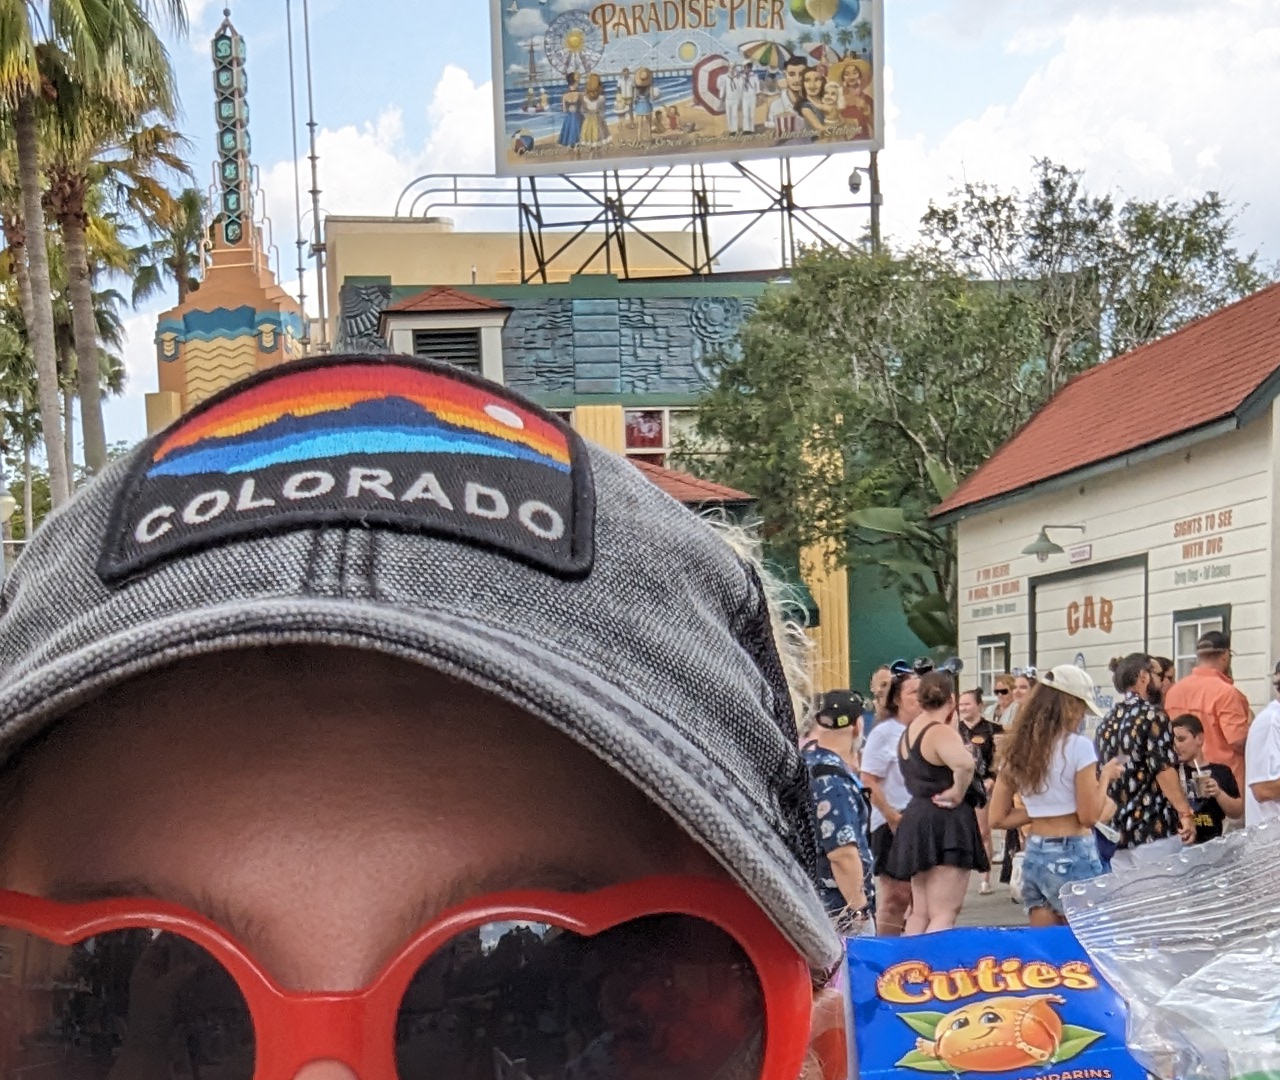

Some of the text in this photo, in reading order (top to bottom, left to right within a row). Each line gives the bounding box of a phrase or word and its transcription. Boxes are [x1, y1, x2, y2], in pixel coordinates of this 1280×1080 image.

[591, 0, 784, 45] PARADISE PIER
[135, 467, 565, 544] COLORADO
[1173, 509, 1233, 538] SIGHTS TO SEE
[1182, 541, 1204, 560] WITH
[1067, 595, 1114, 636] CAB
[876, 955, 1099, 1005] Cuties
